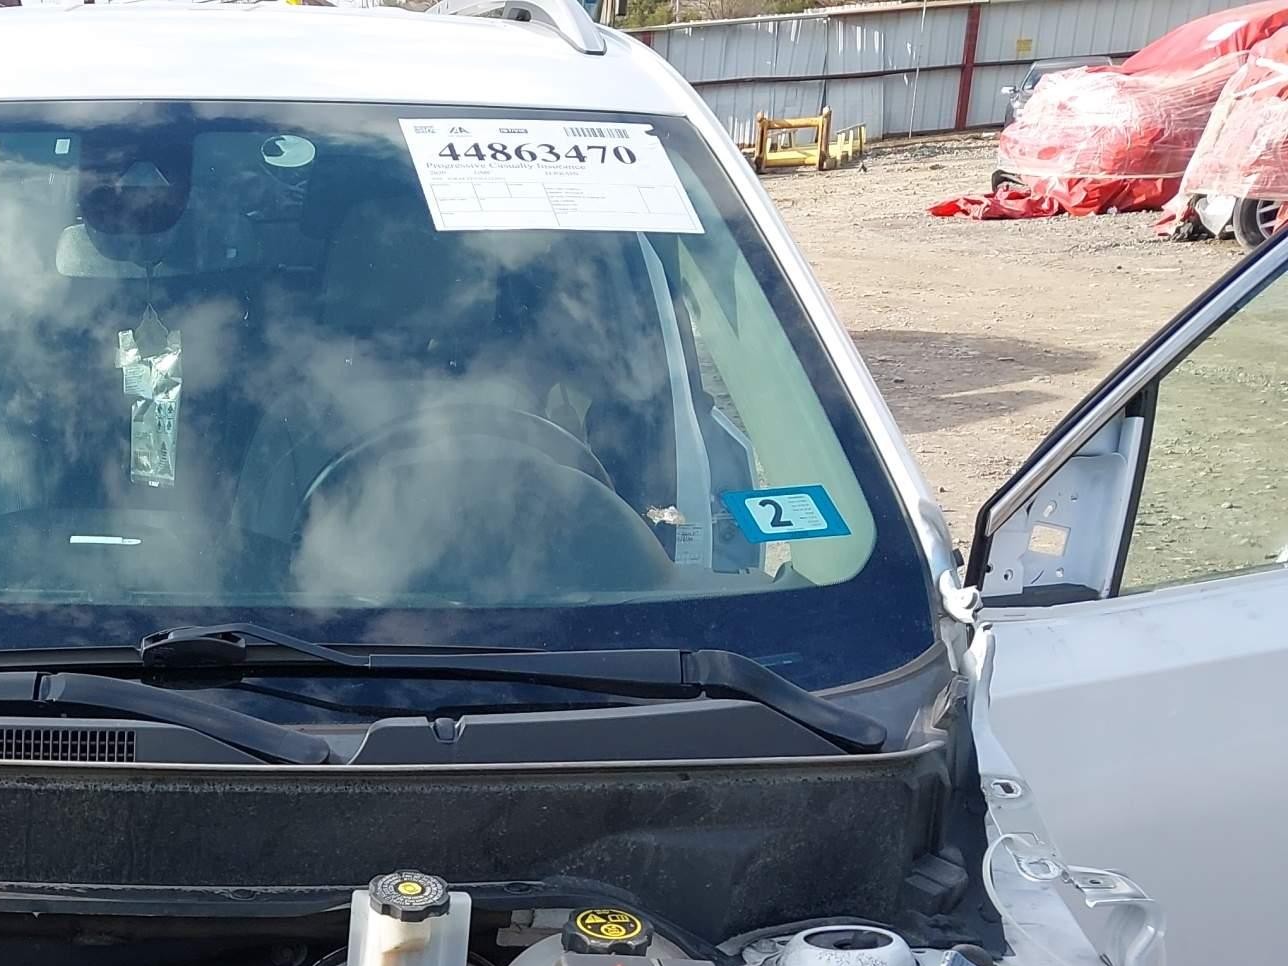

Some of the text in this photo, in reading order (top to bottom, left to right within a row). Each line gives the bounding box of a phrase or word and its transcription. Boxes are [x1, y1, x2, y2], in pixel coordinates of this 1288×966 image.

[438, 142, 637, 164] 44863470
[426, 162, 486, 170] Progressive
[489, 162, 533, 170] Casualty
[759, 499, 793, 527] 2
